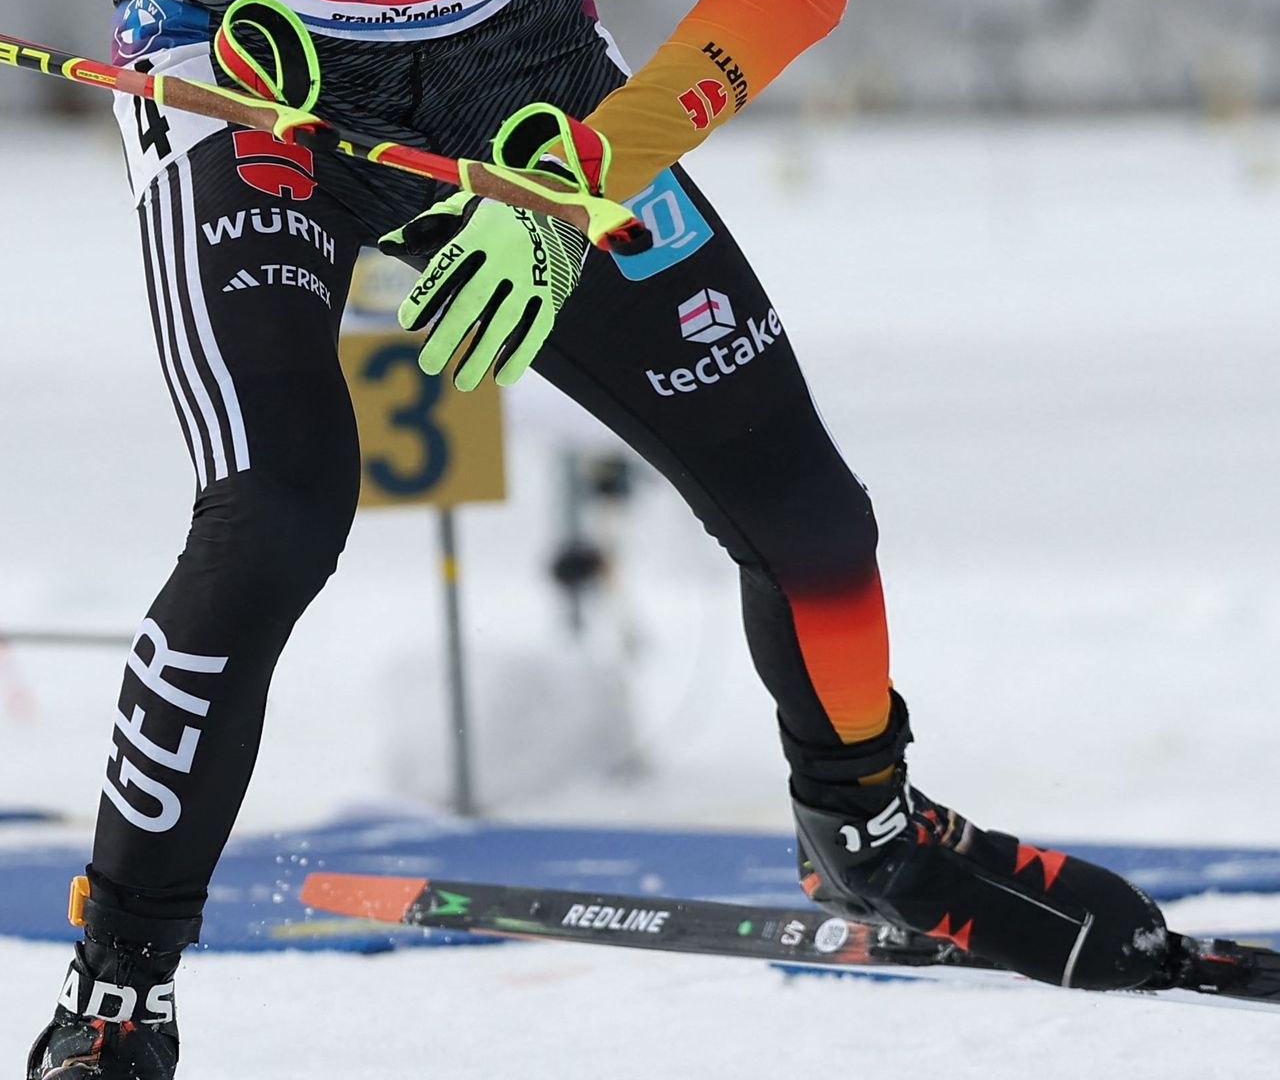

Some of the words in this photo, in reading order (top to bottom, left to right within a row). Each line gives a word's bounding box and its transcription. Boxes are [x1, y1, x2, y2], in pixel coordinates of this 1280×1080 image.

[132, 58, 172, 160] 4
[701, 42, 748, 113] WÜRTH
[202, 208, 335, 265] WÜRTH
[261, 264, 333, 309] TERREX
[645, 306, 782, 397] tectake
[359, 340, 451, 496] 3
[103, 617, 229, 833] GER
[562, 903, 670, 934] REDLINE
